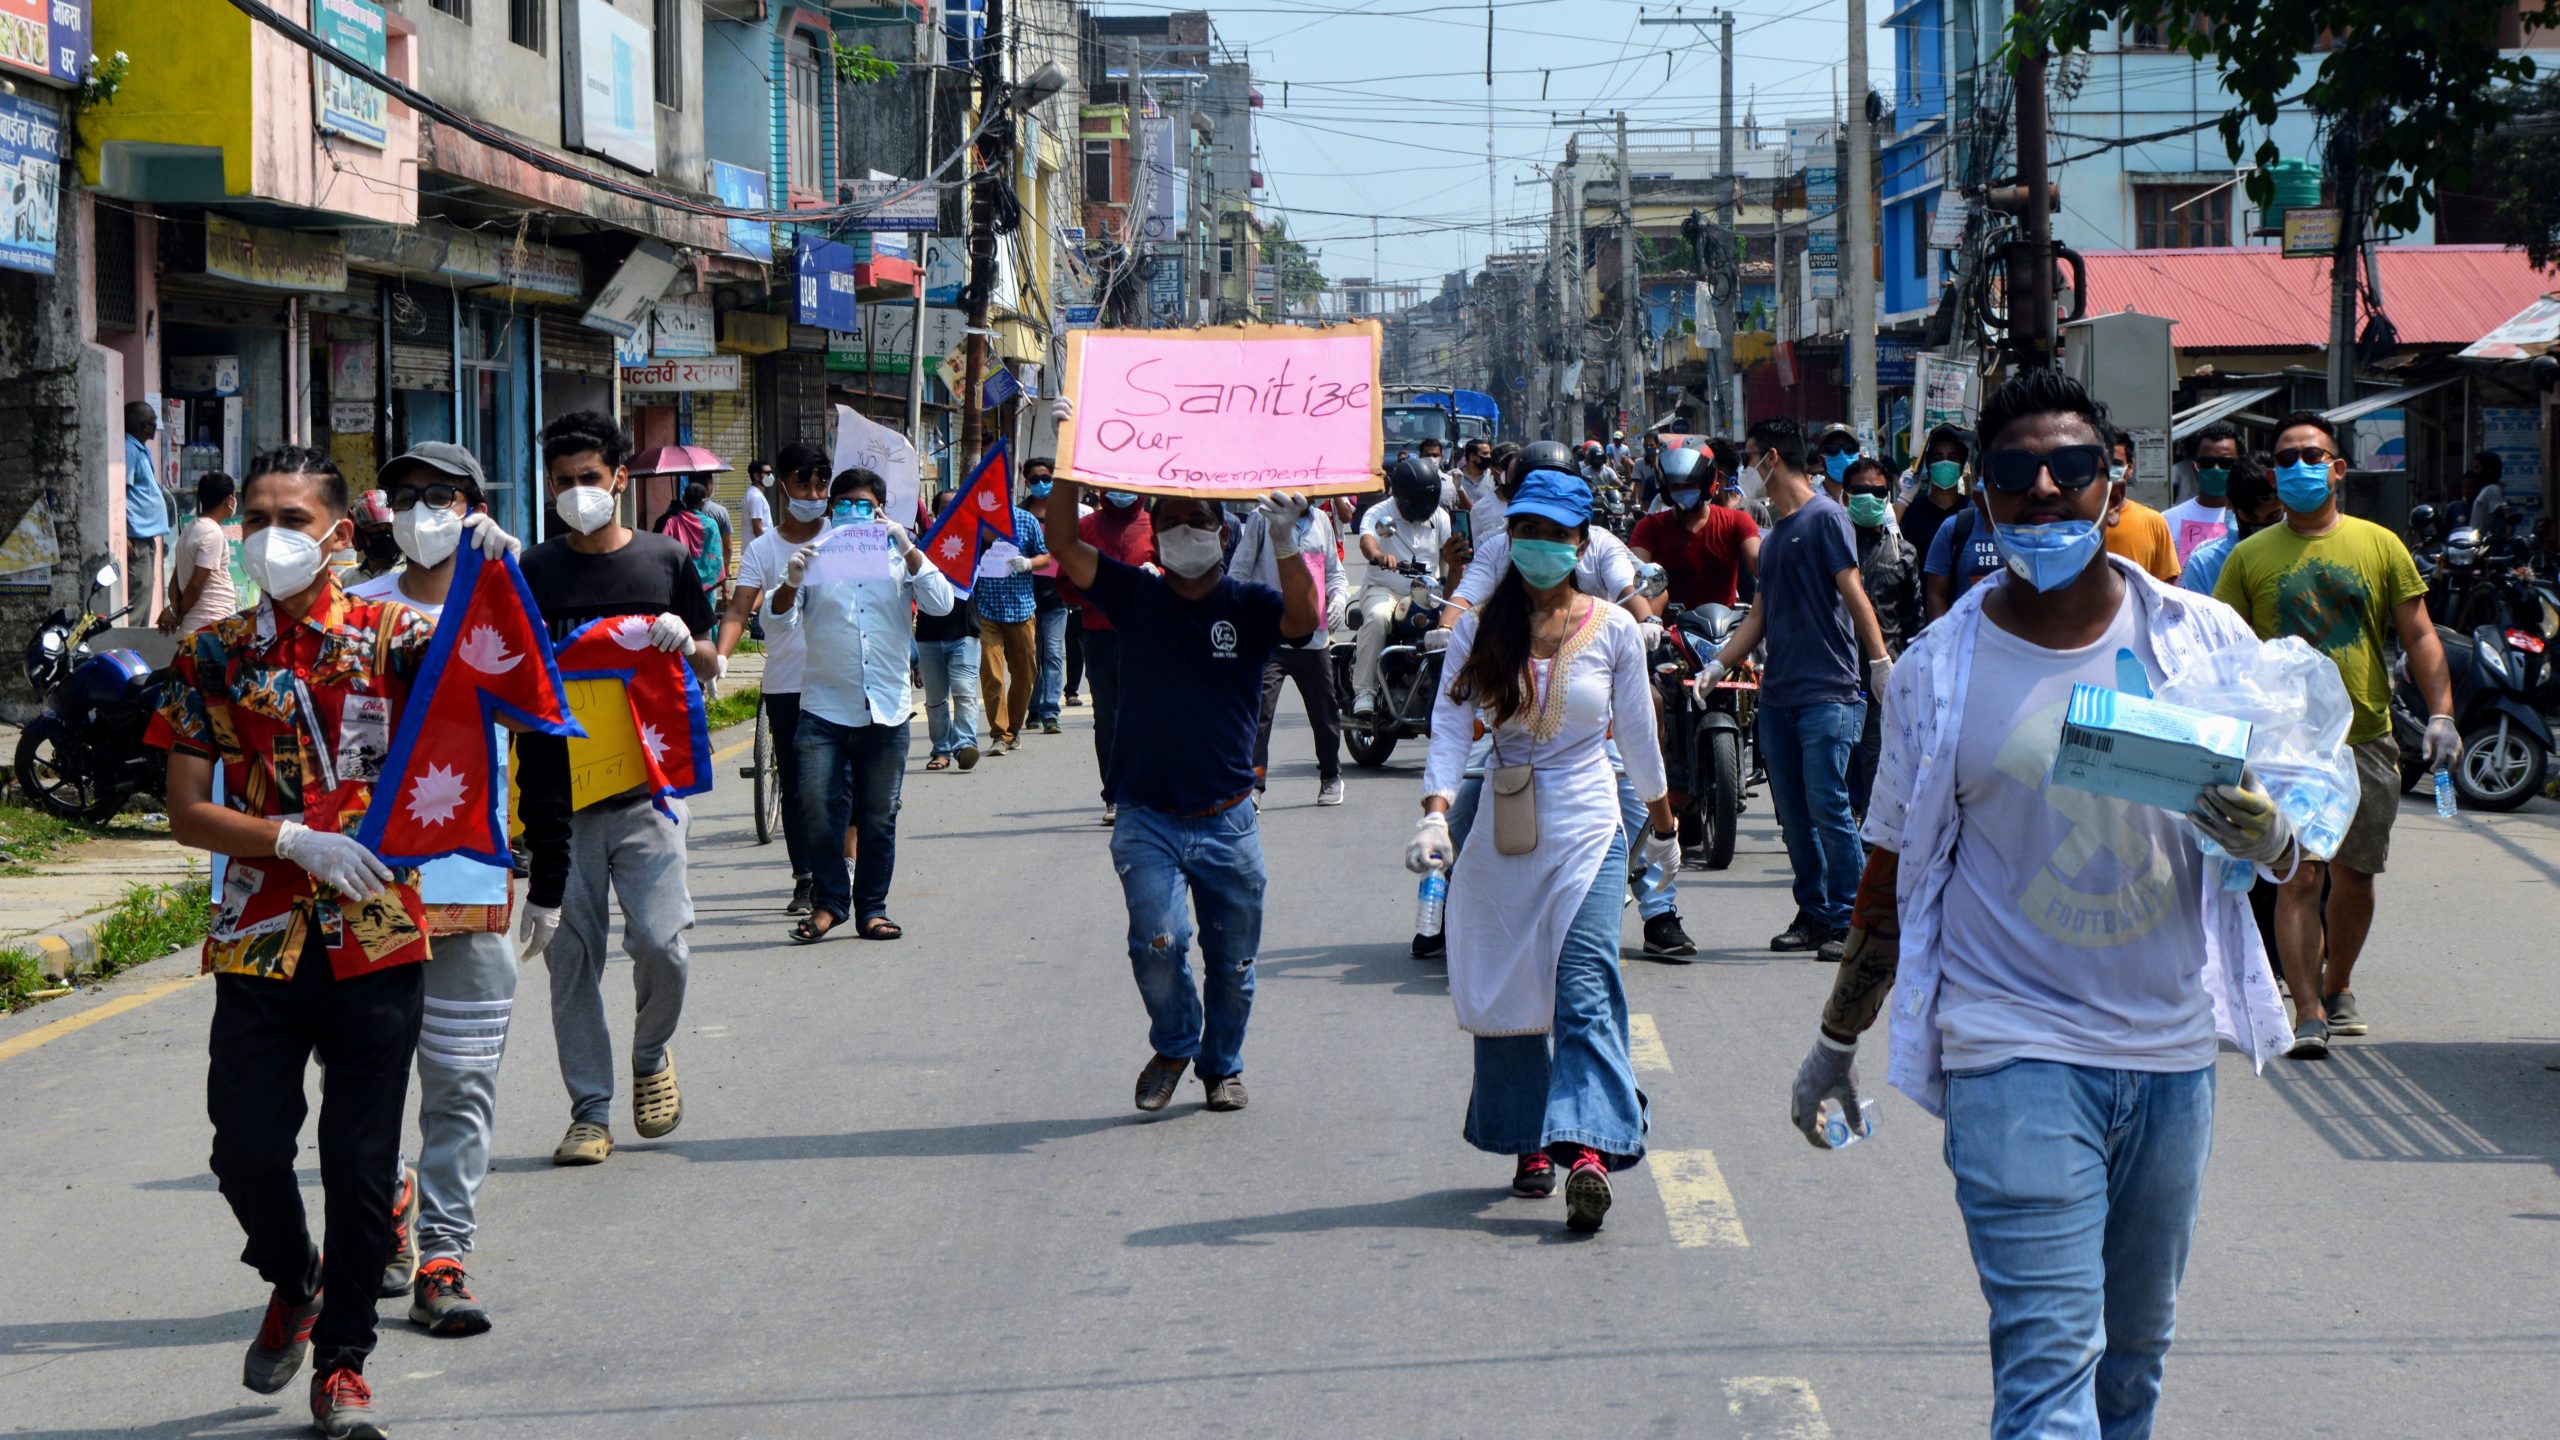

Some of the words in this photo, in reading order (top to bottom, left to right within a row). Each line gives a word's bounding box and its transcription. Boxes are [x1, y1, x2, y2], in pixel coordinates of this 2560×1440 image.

[61, 47, 76, 76] घर
[859, 354, 911, 365] SRINGAR
[1114, 358, 1370, 417] Sanitize
[1097, 419, 1184, 451] Our
[1158, 453, 1329, 482] Government
[1975, 542, 1994, 552] CLO
